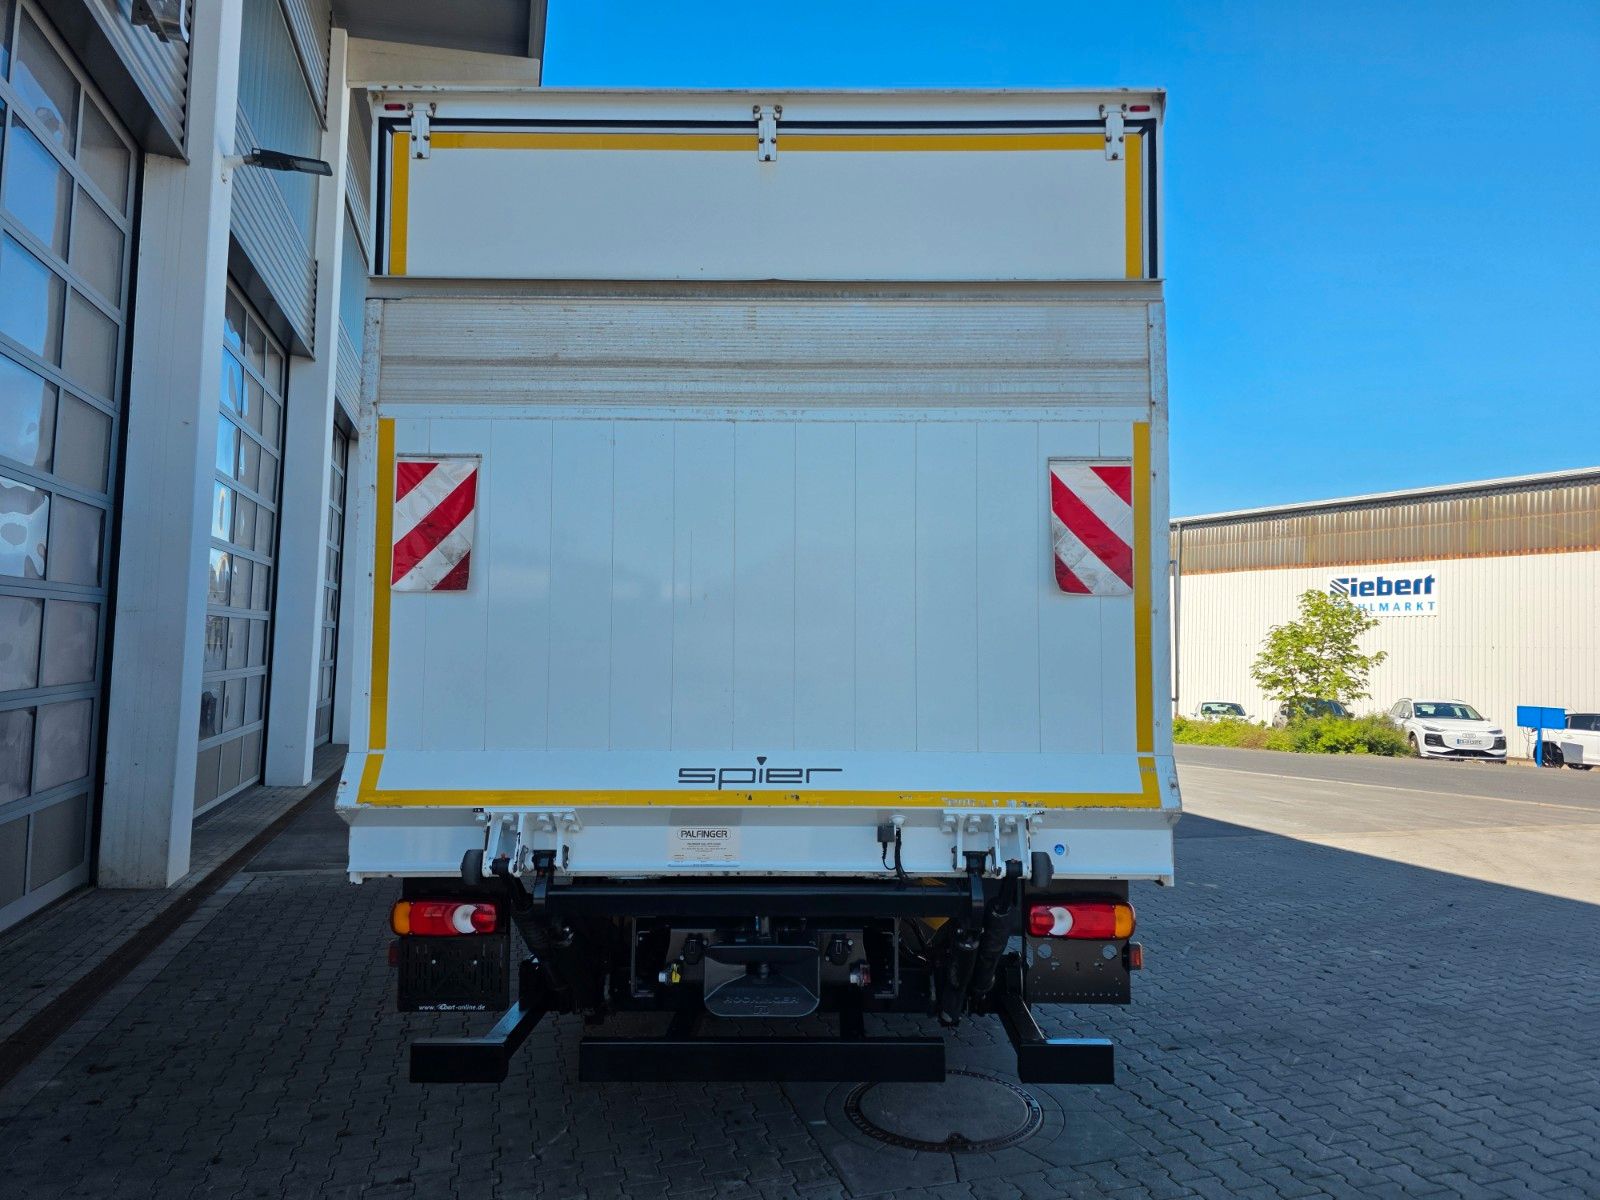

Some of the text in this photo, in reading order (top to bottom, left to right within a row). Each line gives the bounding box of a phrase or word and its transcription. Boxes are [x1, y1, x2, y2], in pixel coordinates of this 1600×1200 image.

[1329, 574, 1436, 598] Siebert
[1333, 601, 1435, 613] HLMARKT
[678, 756, 843, 790] spier
[680, 829, 728, 839] PALFINGER
